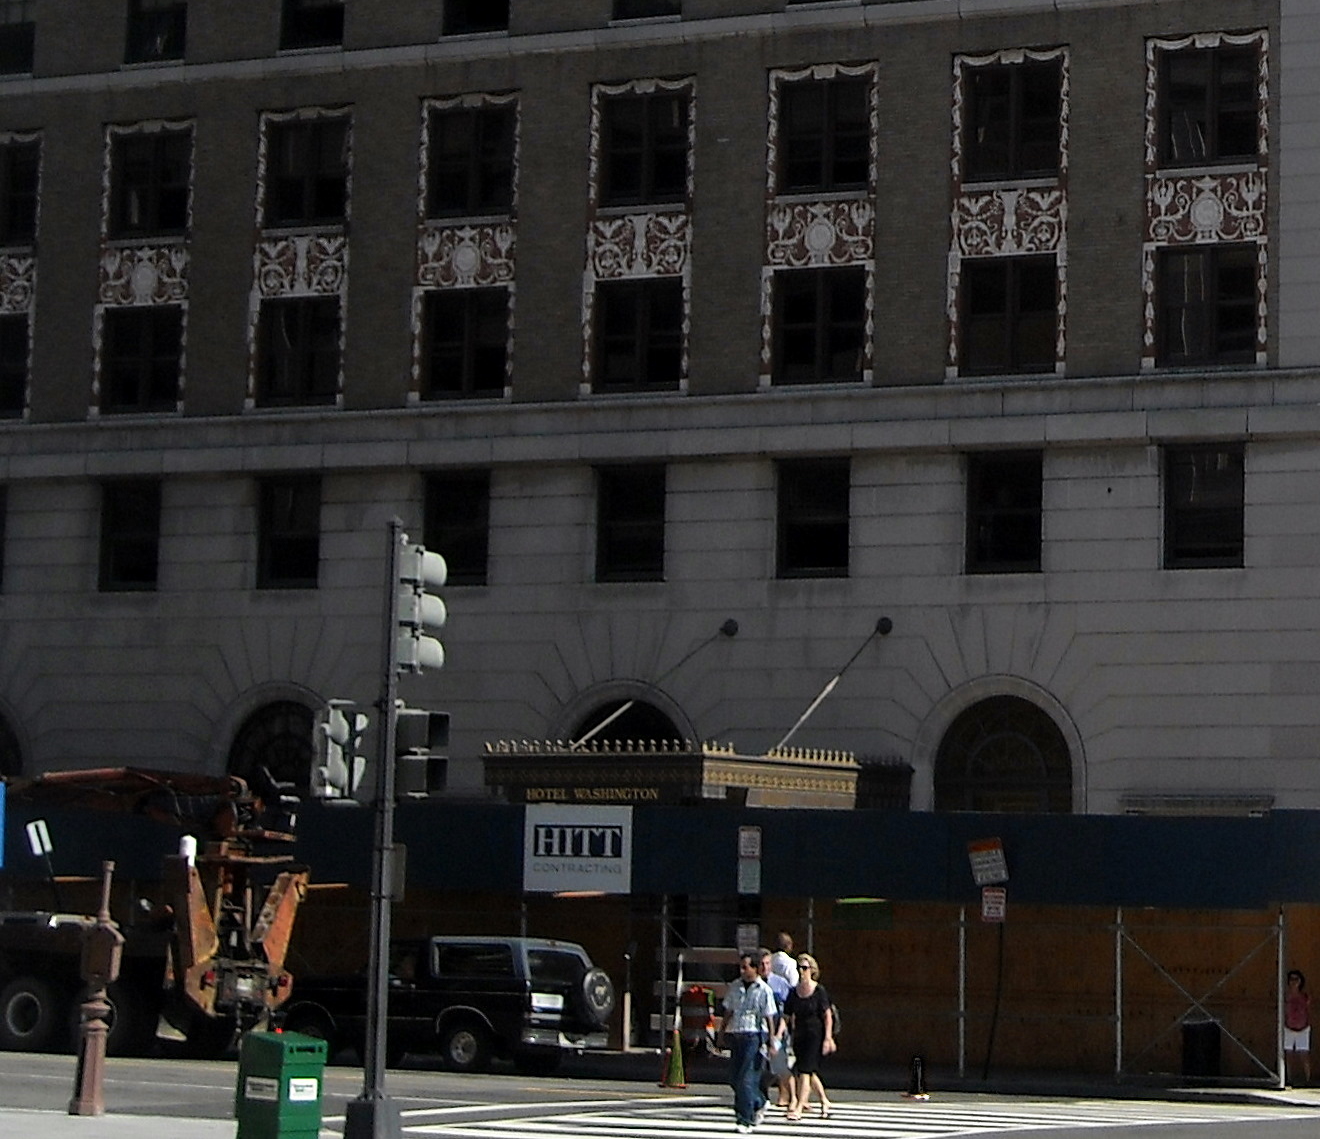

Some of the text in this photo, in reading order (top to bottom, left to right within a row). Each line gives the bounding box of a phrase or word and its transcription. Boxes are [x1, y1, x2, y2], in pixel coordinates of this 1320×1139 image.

[527, 787, 659, 800] HOTEL WASHINGTON
[536, 827, 621, 857] HITT
[532, 862, 622, 874] CONTRACTING
